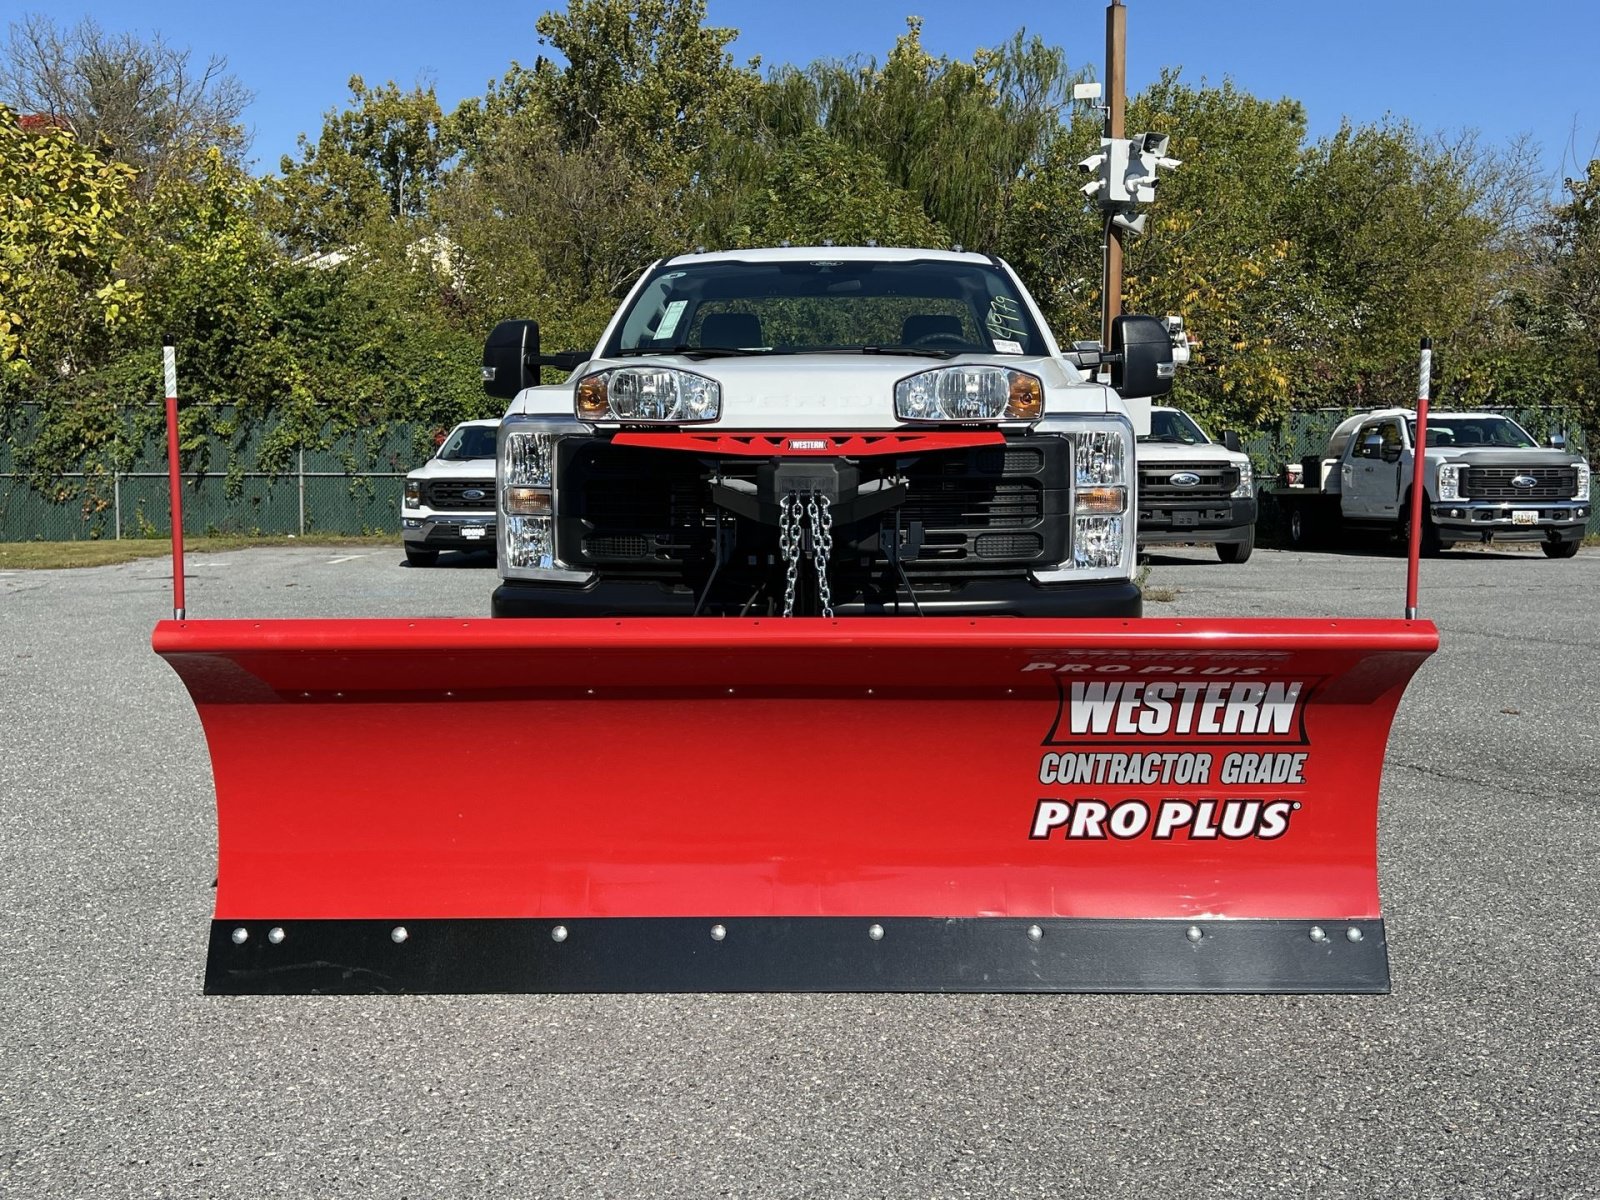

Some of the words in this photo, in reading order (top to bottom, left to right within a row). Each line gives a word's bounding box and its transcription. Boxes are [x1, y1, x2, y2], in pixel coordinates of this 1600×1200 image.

[792, 440, 825, 449] WESTERN
[1069, 681, 1304, 735] WESTERN
[1038, 752, 1213, 785] CONTRACTOR
[1028, 798, 1150, 841] PRO
